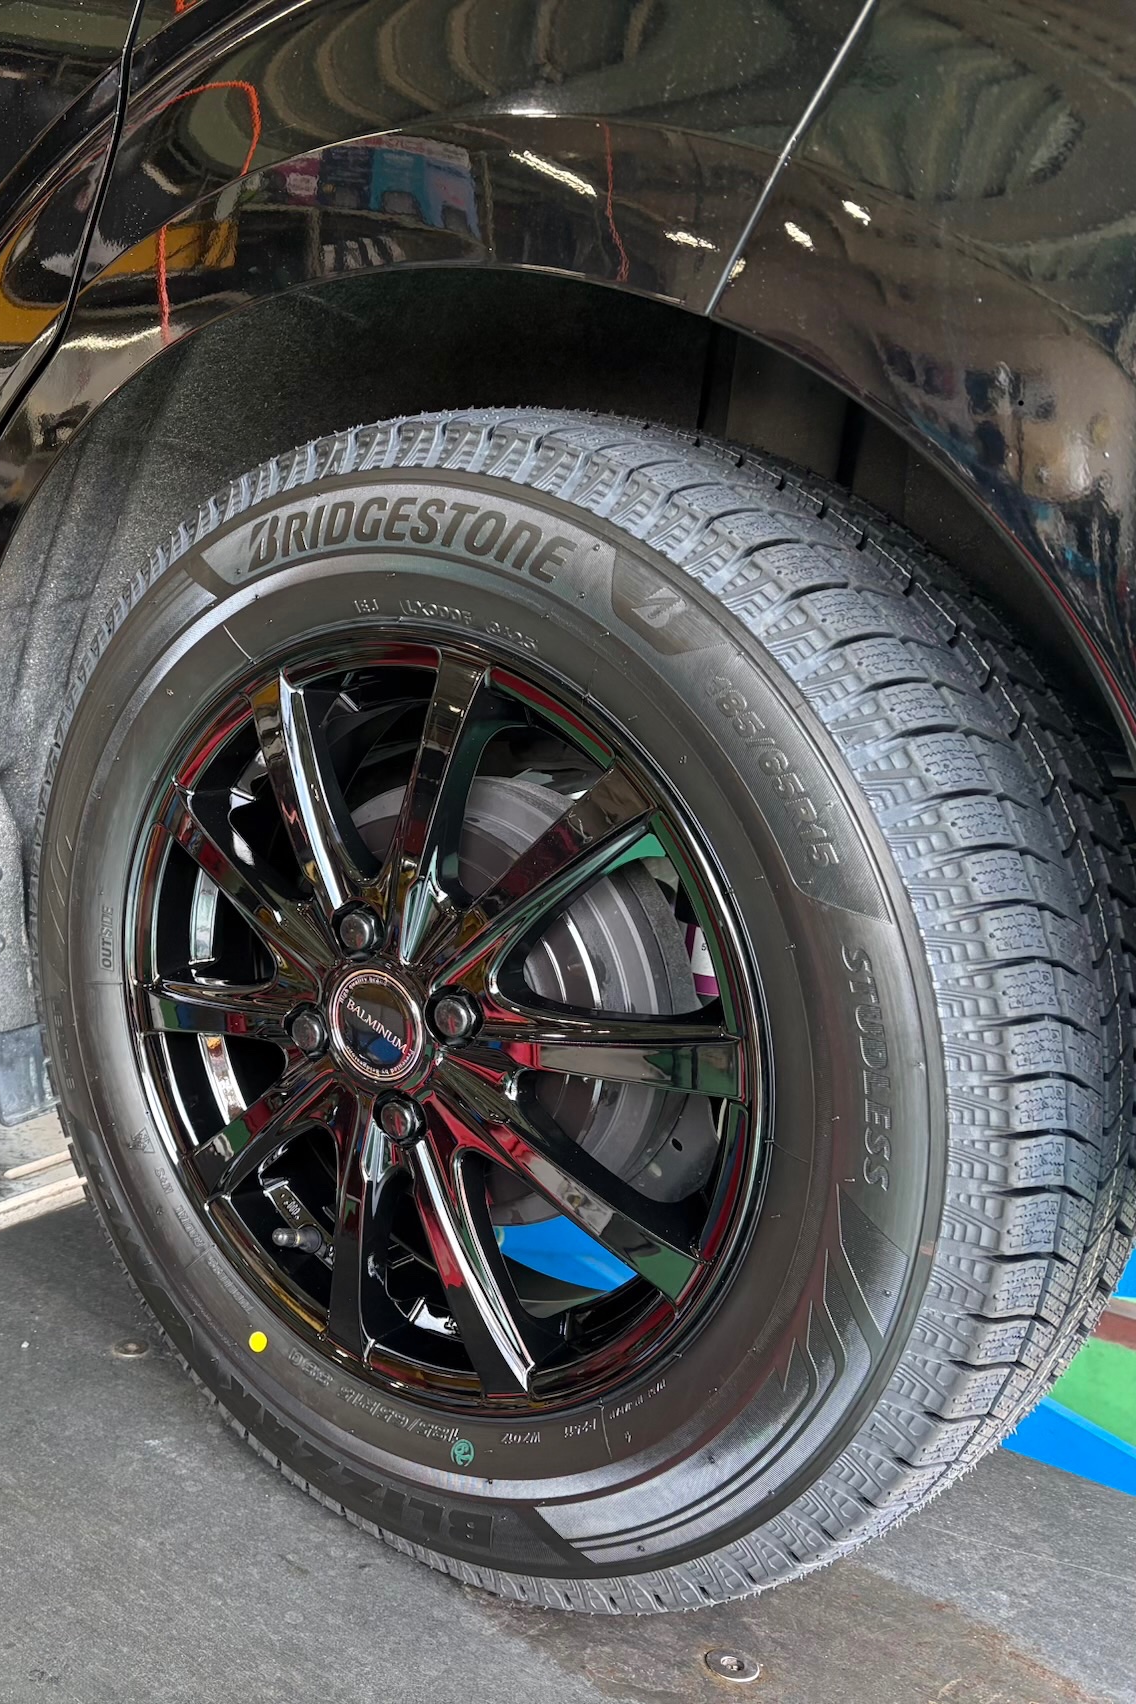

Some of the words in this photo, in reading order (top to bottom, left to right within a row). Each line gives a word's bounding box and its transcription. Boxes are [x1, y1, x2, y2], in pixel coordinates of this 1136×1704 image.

[248, 496, 578, 583] BRIDGESTONE
[707, 675, 839, 869] 185/65R15
[100, 904, 114, 969] OUTSIDE
[346, 998, 408, 1054] BALMINUM
[841, 943, 892, 1193] STUDLESS
[175, 1205, 205, 1247] RADIAL
[219, 1373, 494, 1549] BLIZZAK
